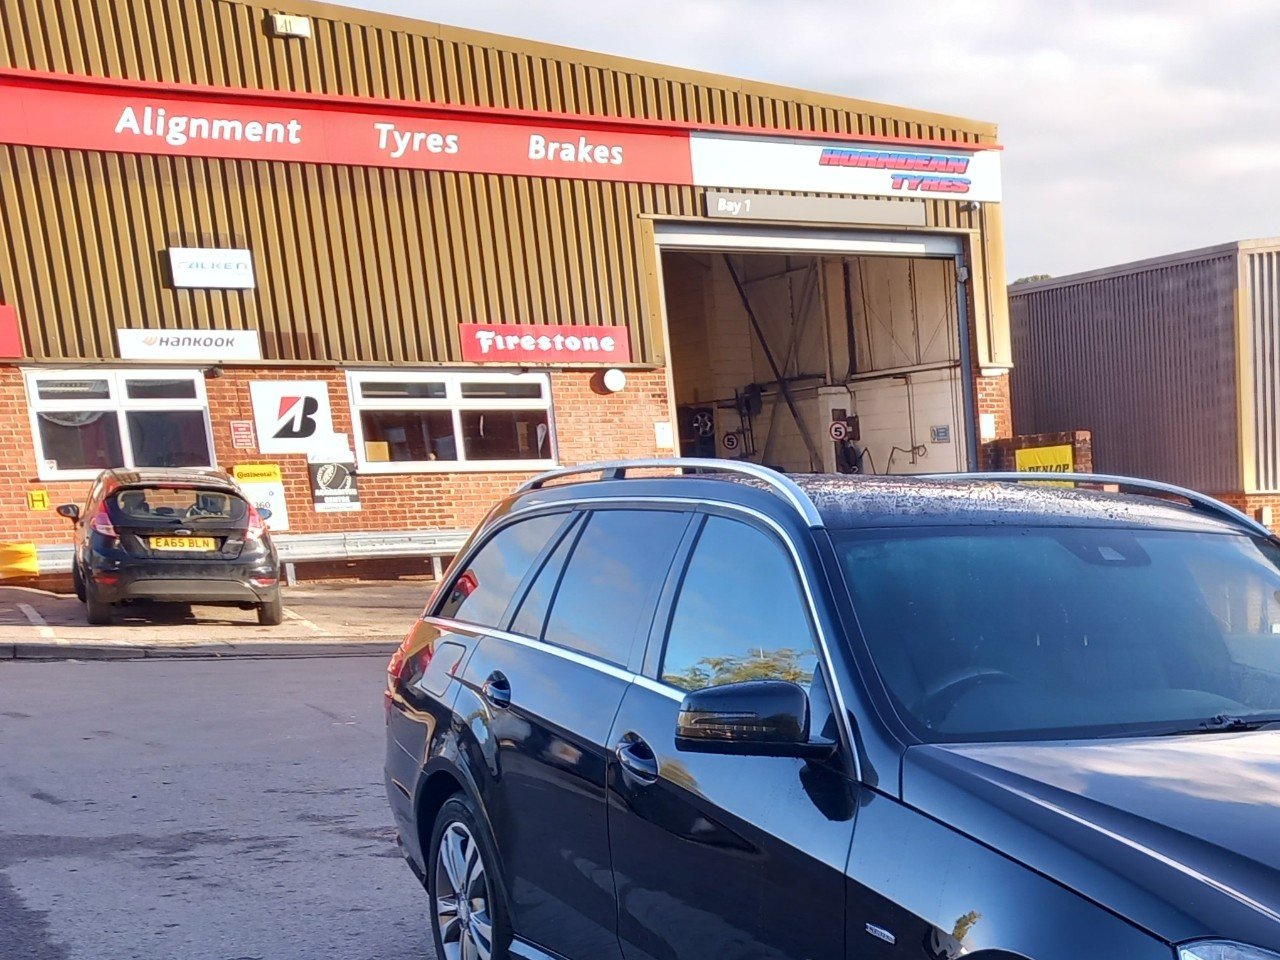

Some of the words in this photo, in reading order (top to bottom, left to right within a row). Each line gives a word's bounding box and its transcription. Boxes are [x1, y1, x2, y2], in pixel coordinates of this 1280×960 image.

[114, 106, 302, 146] Alignment
[374, 123, 459, 158] Tyres
[528, 134, 624, 167] Brakes
[818, 148, 970, 175] HORNDEAN
[891, 173, 972, 194] TYRES
[717, 197, 742, 216] Bay
[744, 199, 751, 213] 1
[475, 329, 616, 354] Firestone
[31, 493, 46, 508] H
[155, 538, 185, 548] EA65
[188, 538, 210, 548] BLN
